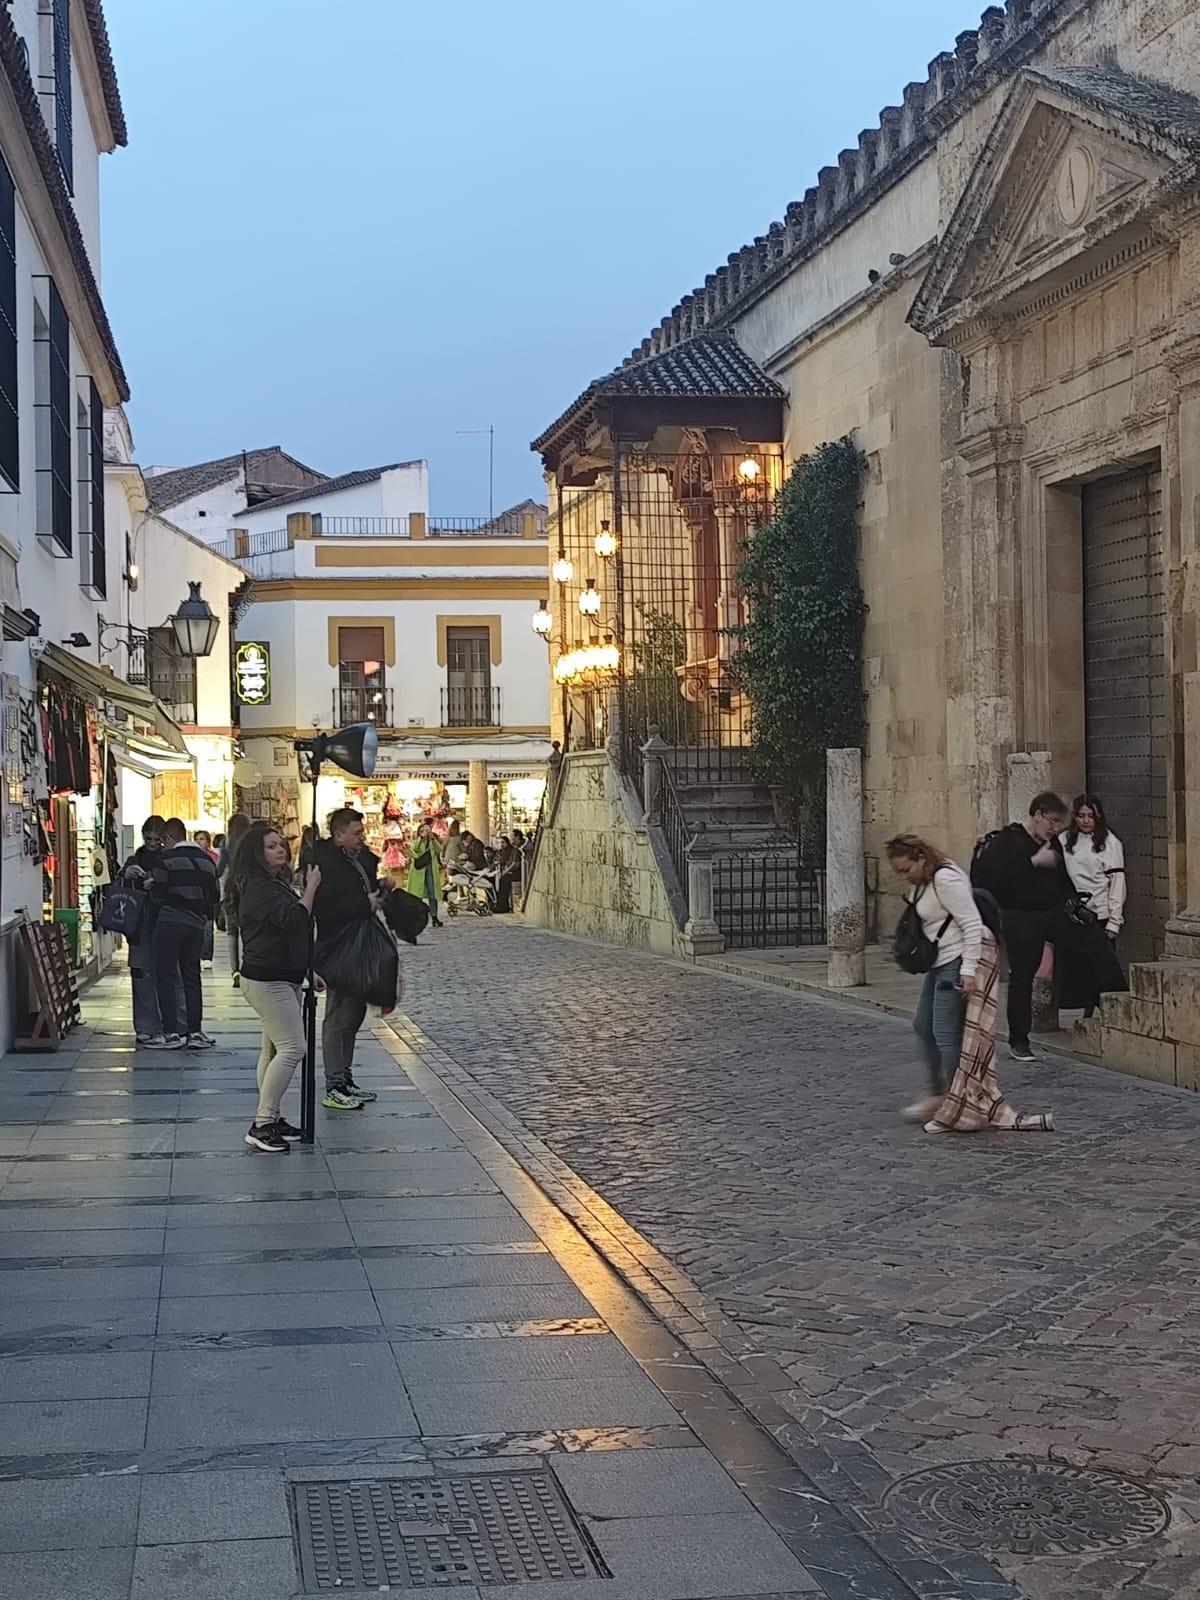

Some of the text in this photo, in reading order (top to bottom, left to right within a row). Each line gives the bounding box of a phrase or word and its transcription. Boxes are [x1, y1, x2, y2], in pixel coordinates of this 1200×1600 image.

[407, 771, 450, 779] Timbre
[455, 771, 470, 779] Se
[491, 771, 531, 780] Stamp
